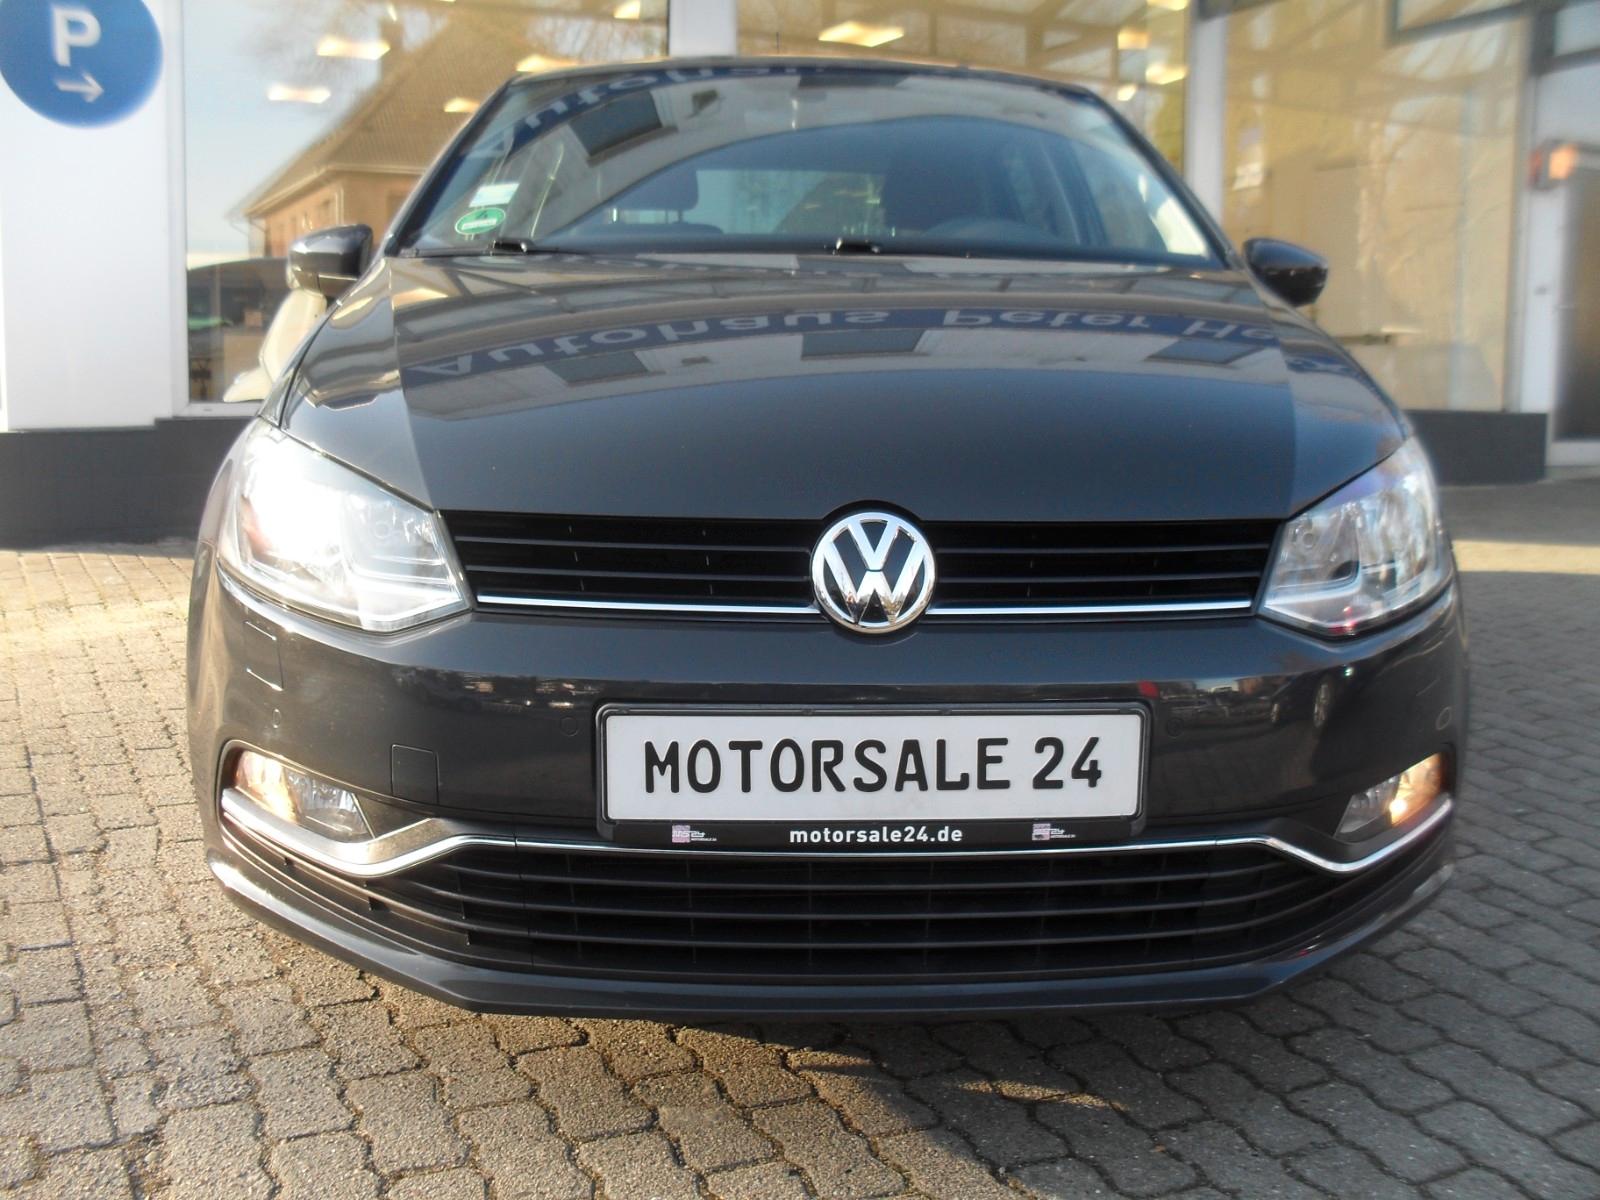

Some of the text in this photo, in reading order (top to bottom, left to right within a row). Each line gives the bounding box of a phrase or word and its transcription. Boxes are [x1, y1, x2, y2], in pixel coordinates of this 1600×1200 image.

[53, 6, 102, 67] P
[813, 512, 935, 633] VW
[643, 736, 1102, 794] MOTORSALE 24
[789, 826, 963, 843] motorsale24.de
